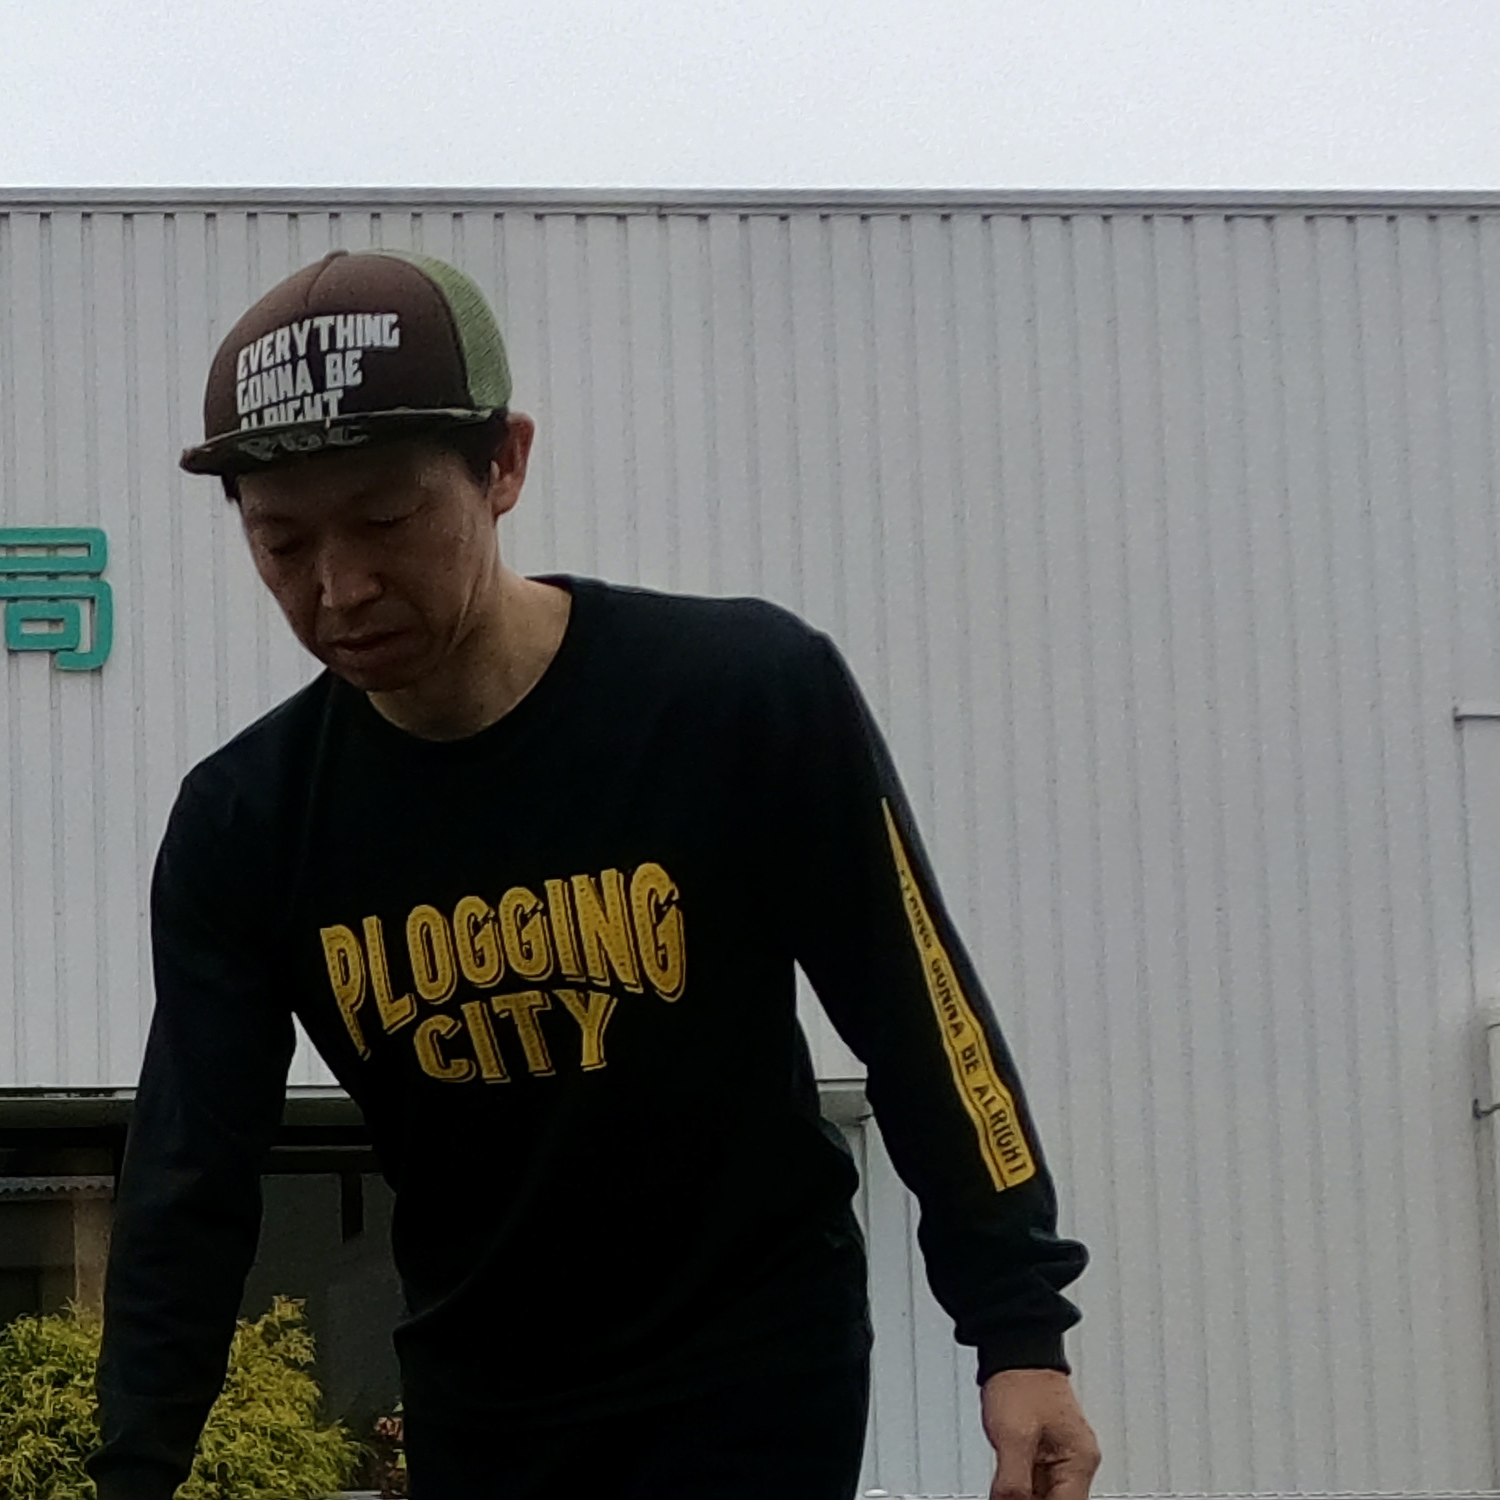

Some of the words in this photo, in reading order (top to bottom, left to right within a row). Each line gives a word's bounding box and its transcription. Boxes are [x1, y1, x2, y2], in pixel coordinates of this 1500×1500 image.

[237, 313, 400, 381] EVERYTHING
[237, 358, 314, 415] GONNA
[325, 349, 363, 389] BE
[319, 862, 687, 1061] PLOGGING
[413, 989, 618, 1084] CITY
[962, 1042, 980, 1075] BE
[974, 1085, 1027, 1174] ALRIGHT
